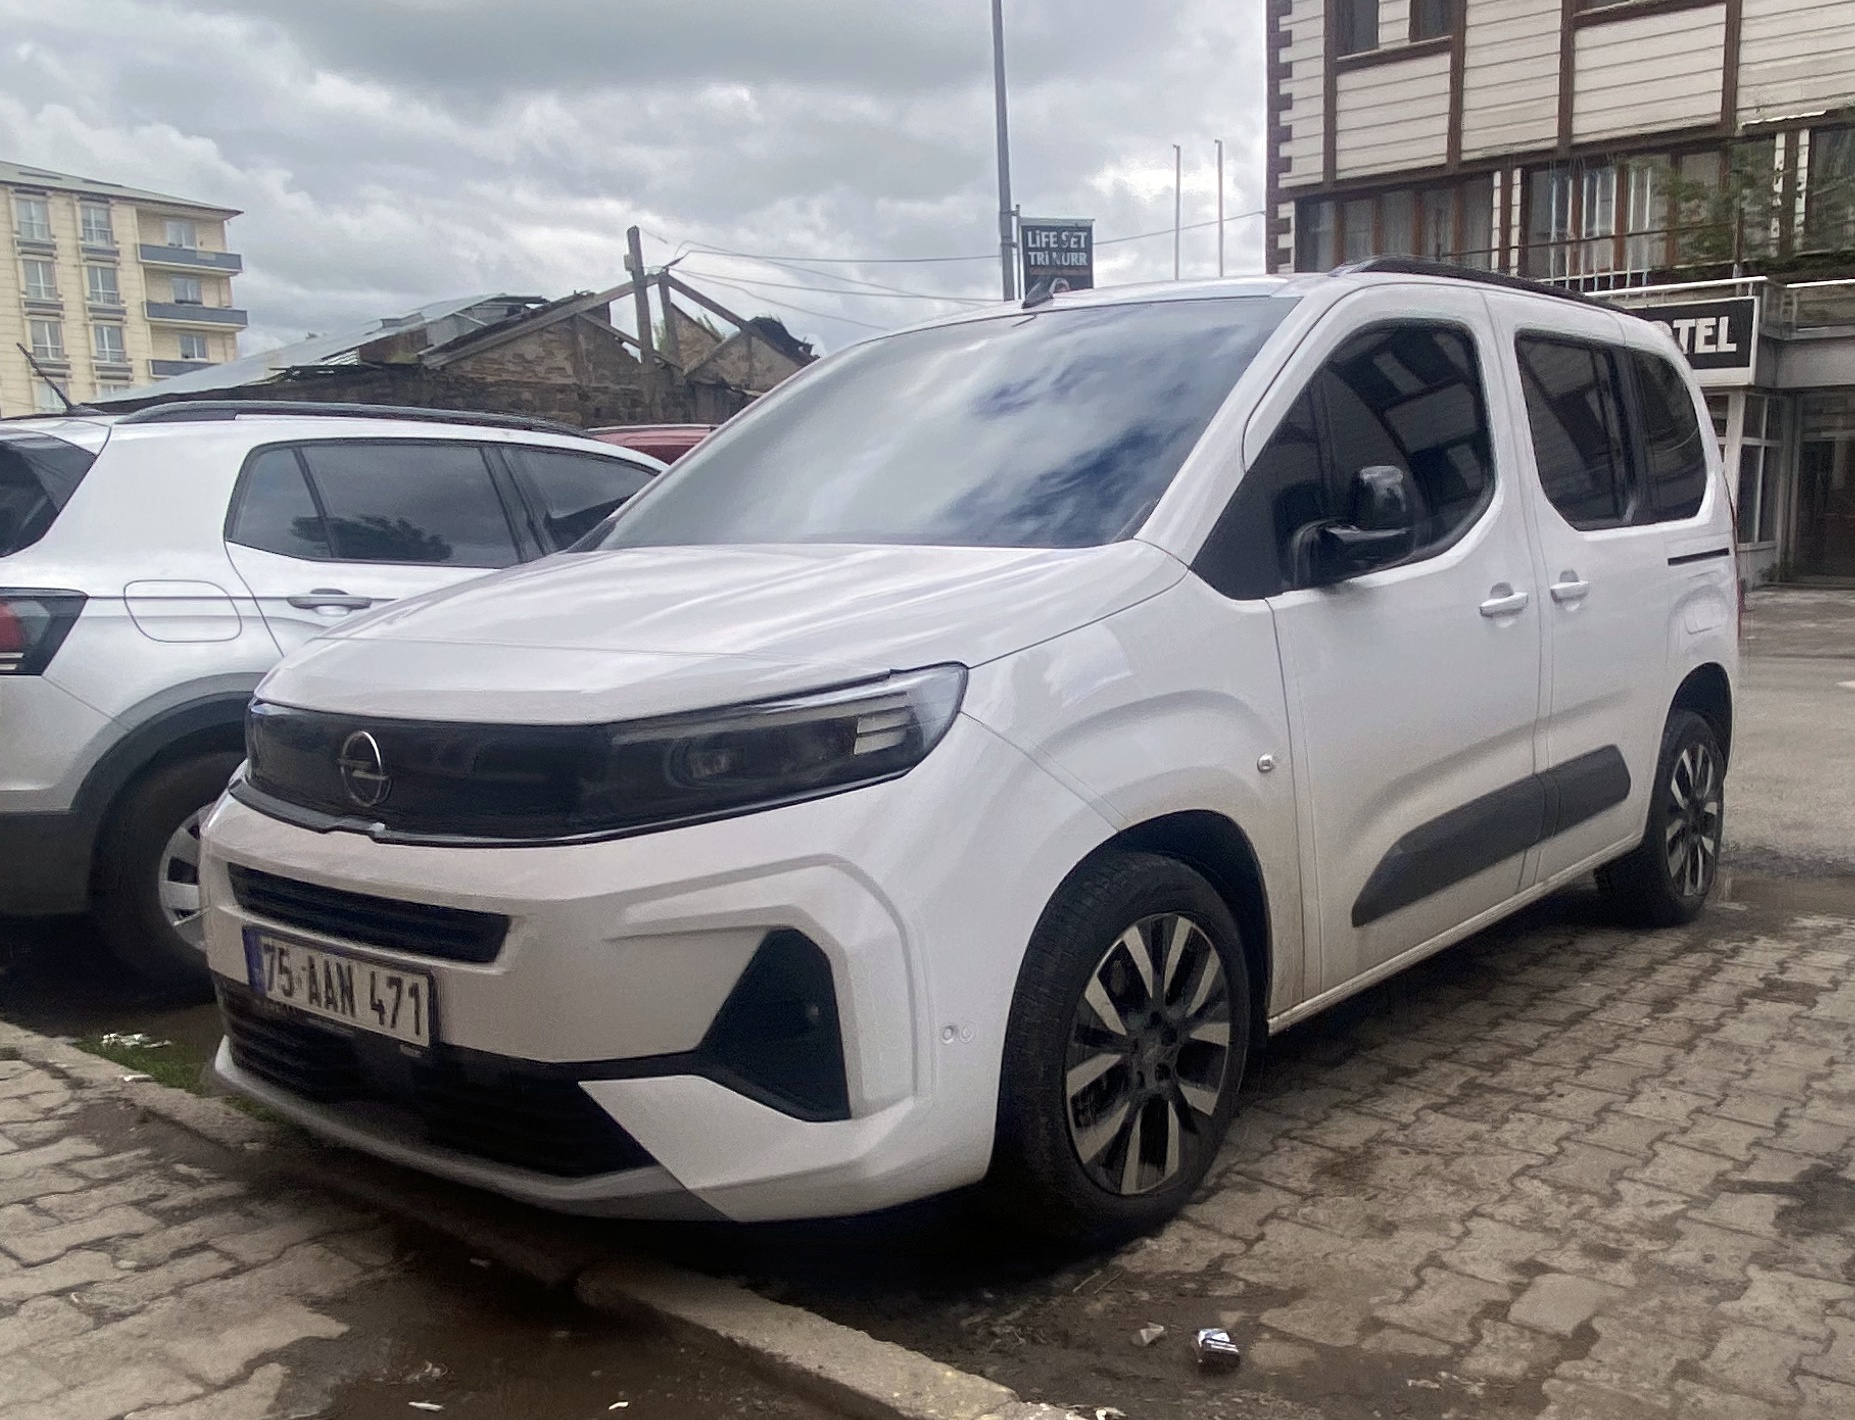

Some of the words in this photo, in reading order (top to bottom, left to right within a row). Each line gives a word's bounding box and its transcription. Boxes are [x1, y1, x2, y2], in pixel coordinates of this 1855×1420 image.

[262, 943, 294, 997] 75
[307, 955, 356, 1018] AAN
[369, 971, 421, 1036] 471
